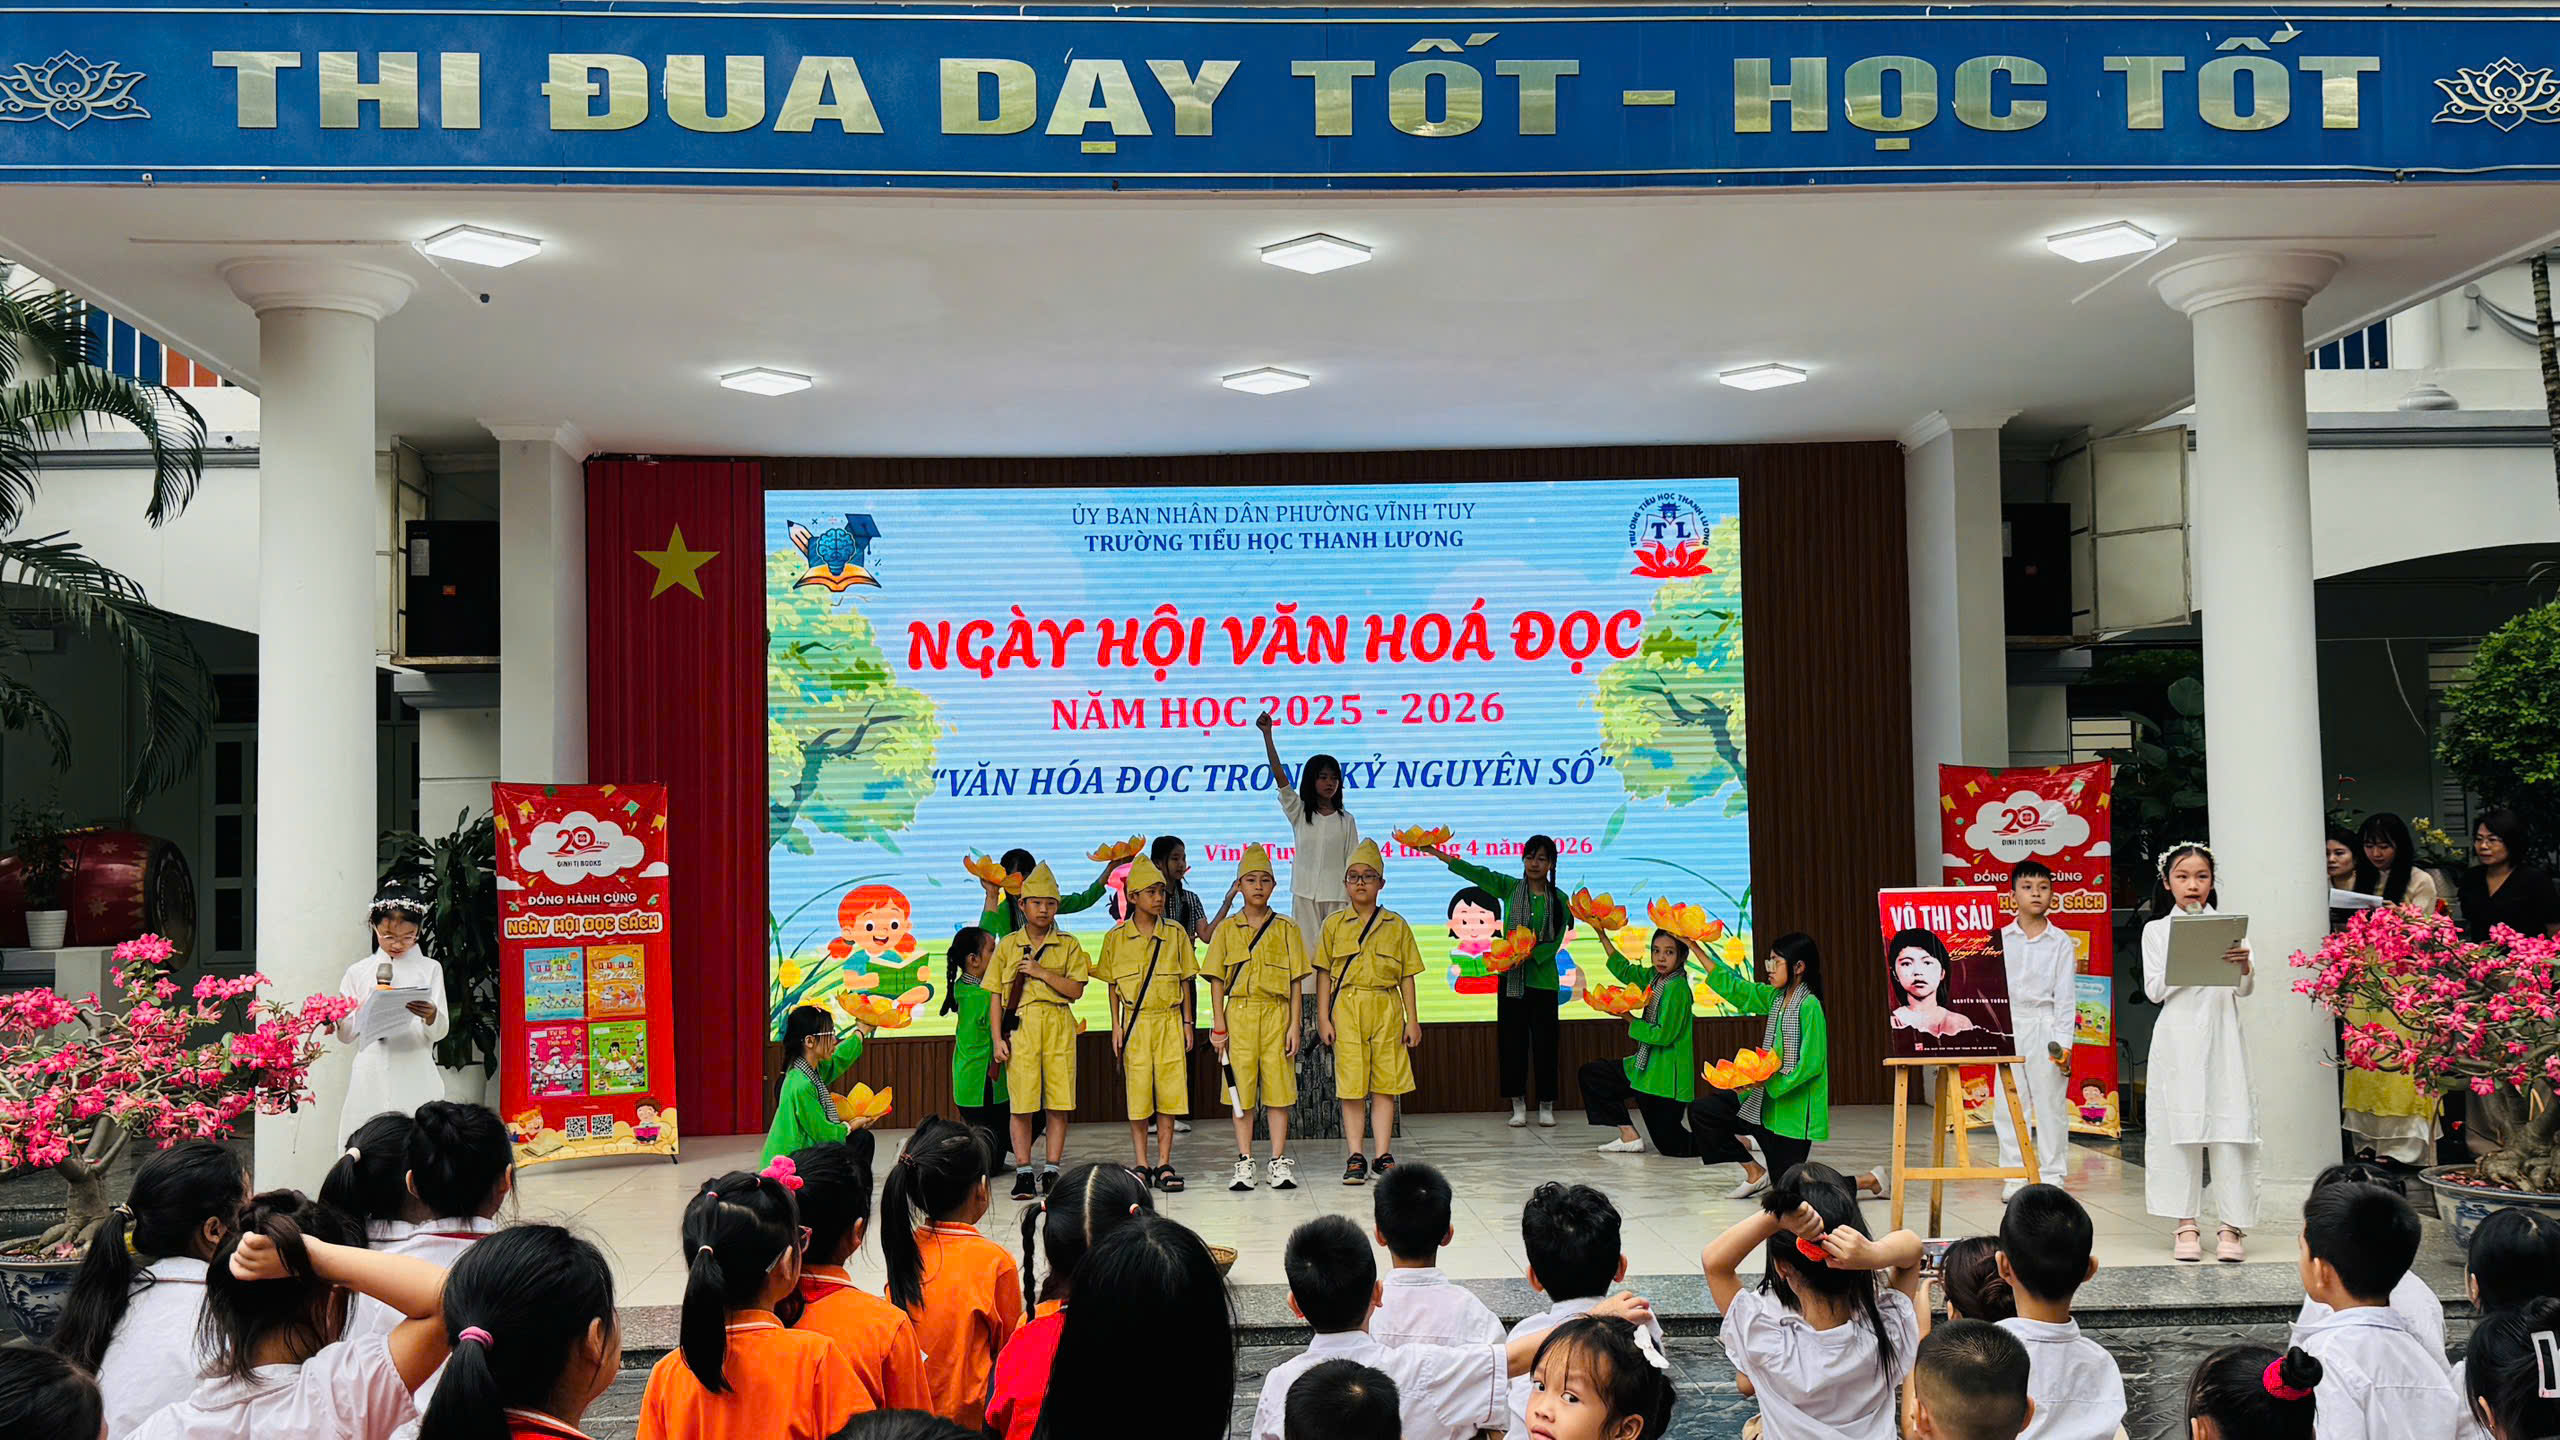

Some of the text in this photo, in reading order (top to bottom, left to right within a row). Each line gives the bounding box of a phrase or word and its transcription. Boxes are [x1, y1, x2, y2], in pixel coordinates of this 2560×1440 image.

[212, 30, 2381, 154] THI ĐUA DẠY TỐT - HỌC TỐT
[1071, 500, 1476, 525] ỦY BAN NHÂN DÂN PHƯỜNG VĨNH TUY
[1677, 494, 1704, 516] THANH
[1084, 528, 1464, 554] TRƯỜNG TIỂU HỌC THANH LƯƠNG
[908, 597, 1642, 683] NGÀY HỘI VĂN HOÁ ĐỌC
[1052, 690, 1146, 731] NĂM
[1161, 697, 1247, 737] HỌC
[1259, 694, 1363, 727] 2025
[1401, 691, 1505, 725] 2026
[1027, 758, 1104, 796] HÓA
[1116, 764, 1194, 801] ĐỌC
[1203, 762, 1303, 792] TRON
[1341, 752, 1387, 789] KỶ
[1392, 750, 1542, 789] NGUYÊN
[2001, 805, 2040, 833] 20
[556, 825, 596, 854] 20
[1204, 843, 1249, 862] Vĩn
[1466, 839, 1479, 856] 4
[1553, 837, 1593, 855] 026
[2025, 838, 2046, 846] BOOKS
[1973, 870, 2008, 883] ĐỒNG
[528, 891, 638, 906] ĐỒNG HÀNH CÙNG
[2064, 891, 2104, 911] SÁCH
[507, 910, 660, 936] NGÀY HỘI ĐỌC SÁCH
[1890, 899, 1994, 934] VÕ THỊ SÁU
